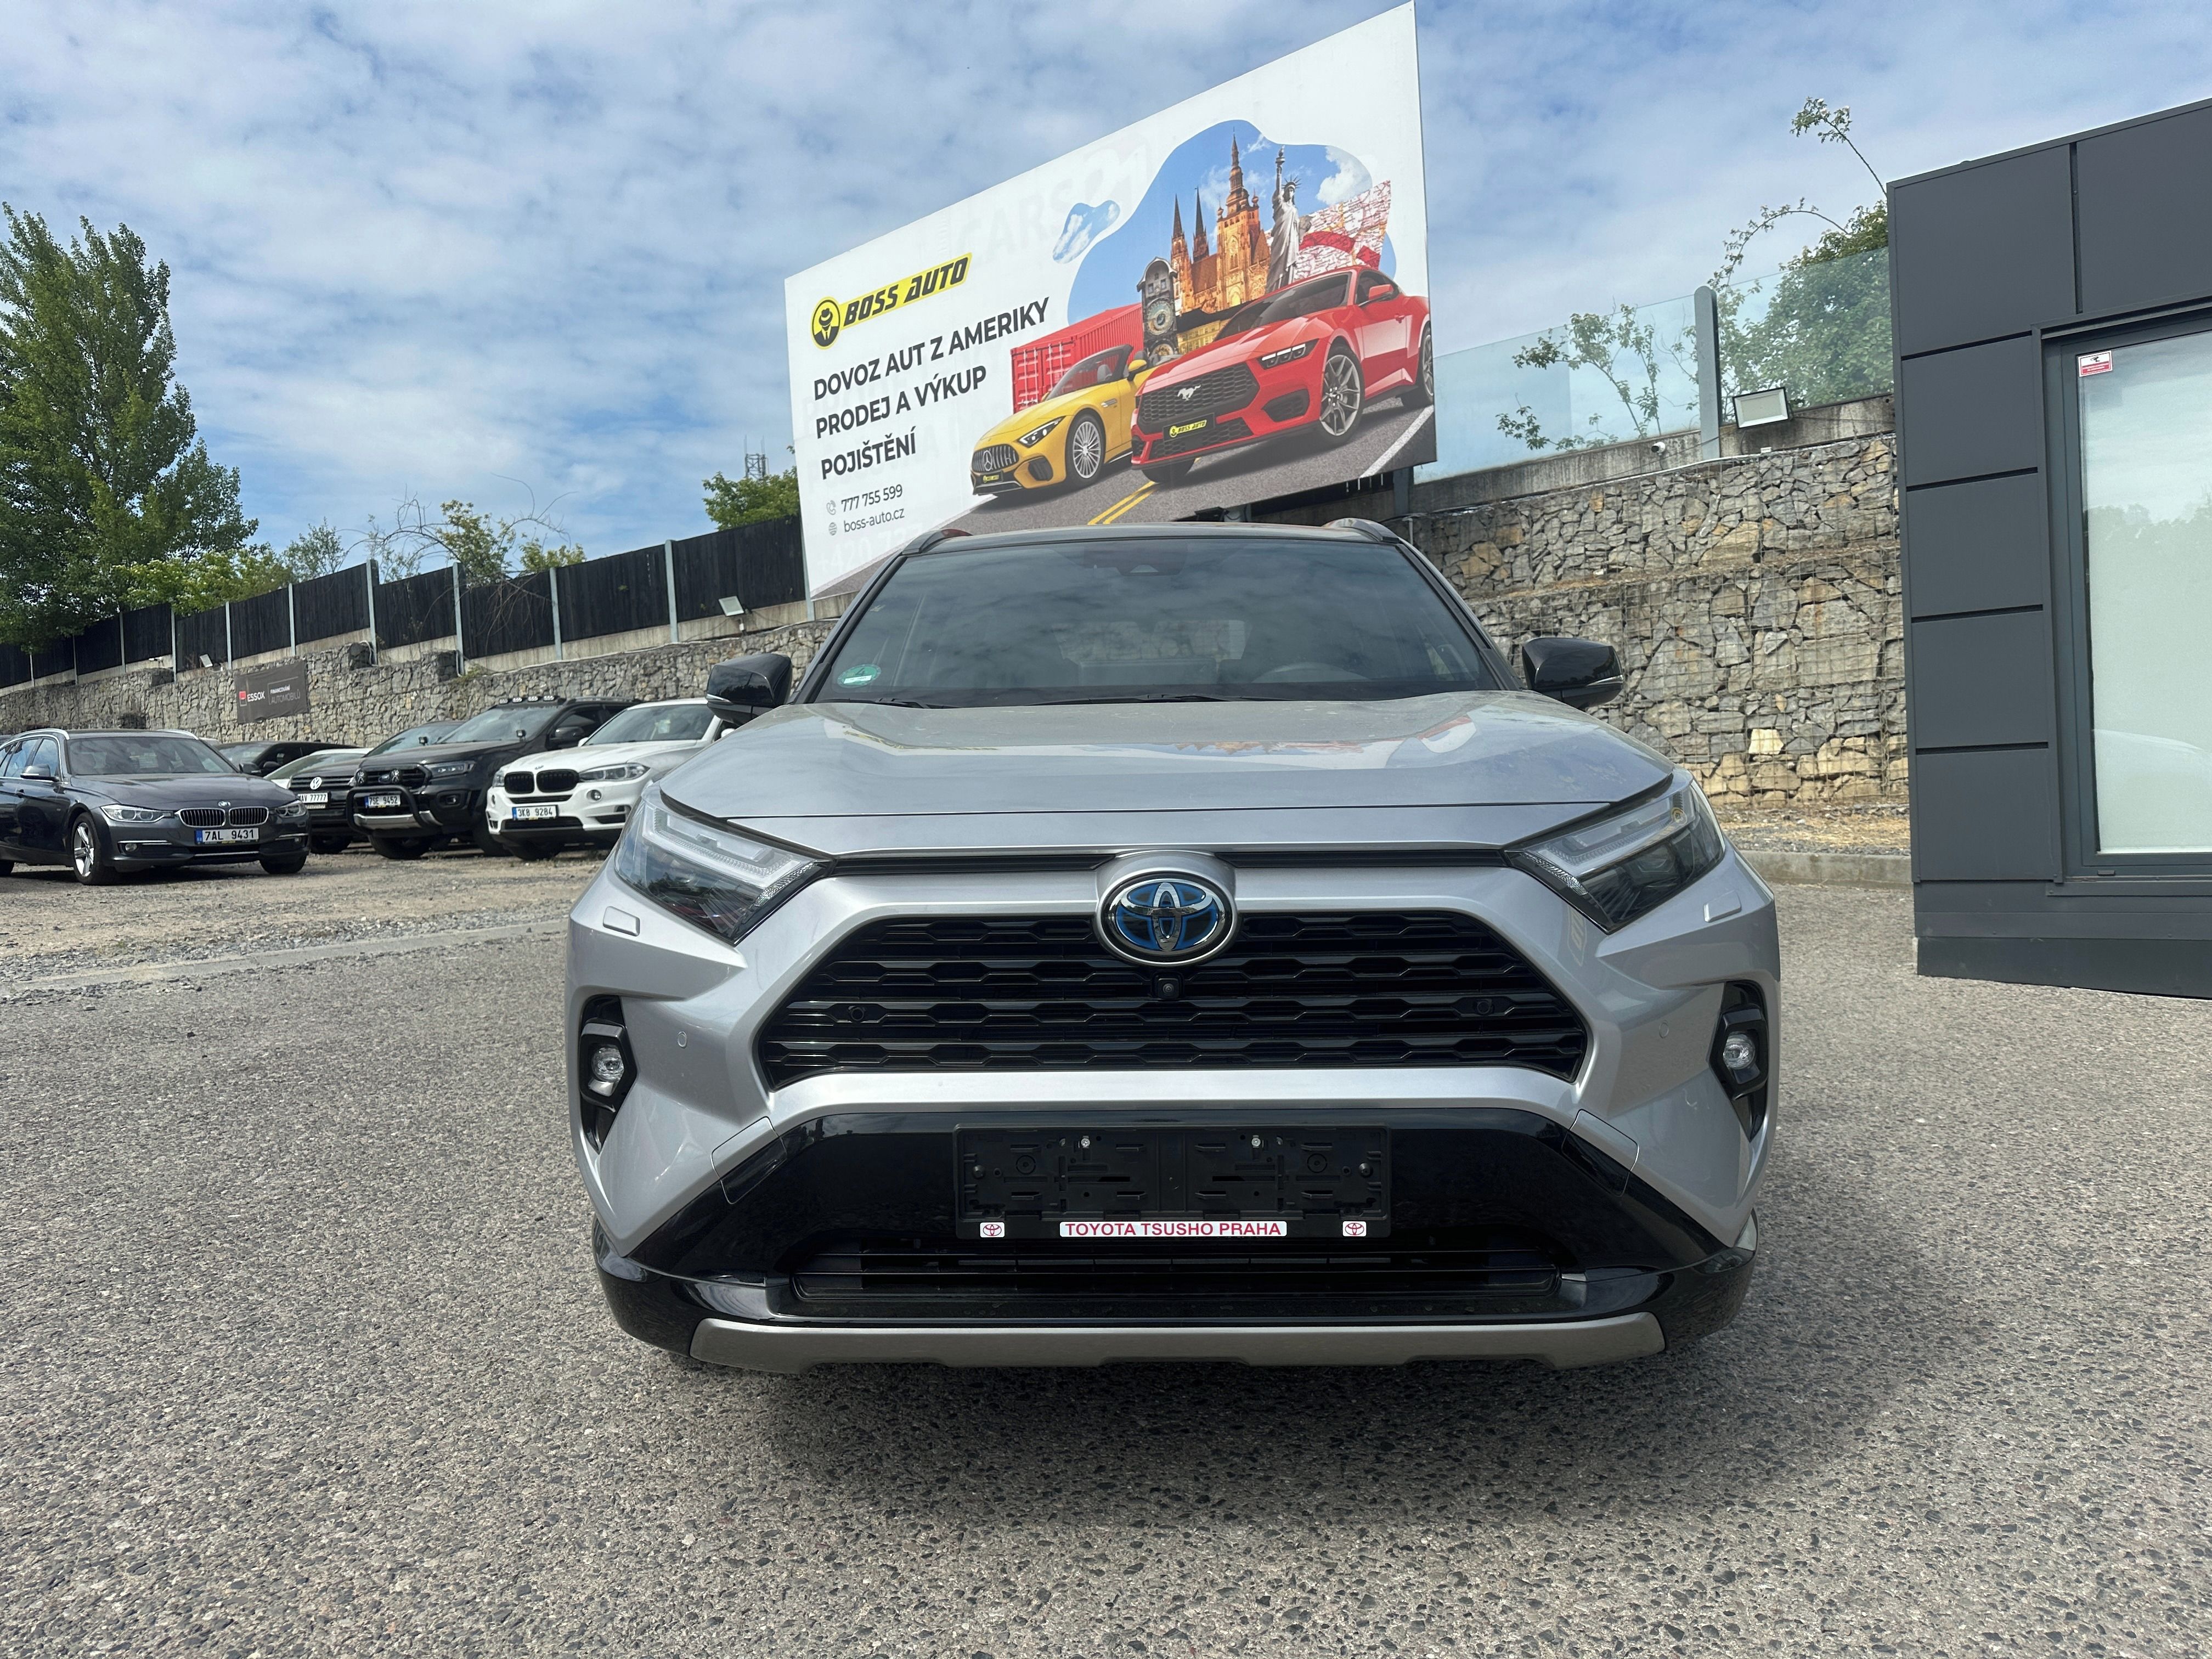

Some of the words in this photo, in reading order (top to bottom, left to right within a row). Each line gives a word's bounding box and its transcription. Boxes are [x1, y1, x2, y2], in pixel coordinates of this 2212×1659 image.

[843, 284, 899, 327] BOSS
[903, 257, 968, 304] AUTO
[814, 358, 880, 401] DOVOZ
[885, 342, 925, 377] AUT
[930, 336, 944, 362] Z
[948, 296, 1049, 355] AMERIKY
[816, 396, 890, 439] PRODEJ
[895, 391, 911, 415] A
[914, 365, 987, 407] VÝKUP
[821, 426, 916, 480] POJIŠTĚNÍ
[841, 495, 860, 513] 777
[862, 490, 881, 507] 755
[883, 484, 903, 501] 599
[844, 508, 905, 533] boss-auto.cz
[247, 691, 266, 702] ESSOX
[205, 831, 224, 840] 7AL
[231, 829, 254, 839] 9431
[1065, 1223, 1136, 1235] TOYOTA
[1141, 1223, 1214, 1235] TSUSHO
[1219, 1223, 1282, 1235] PRAHA
